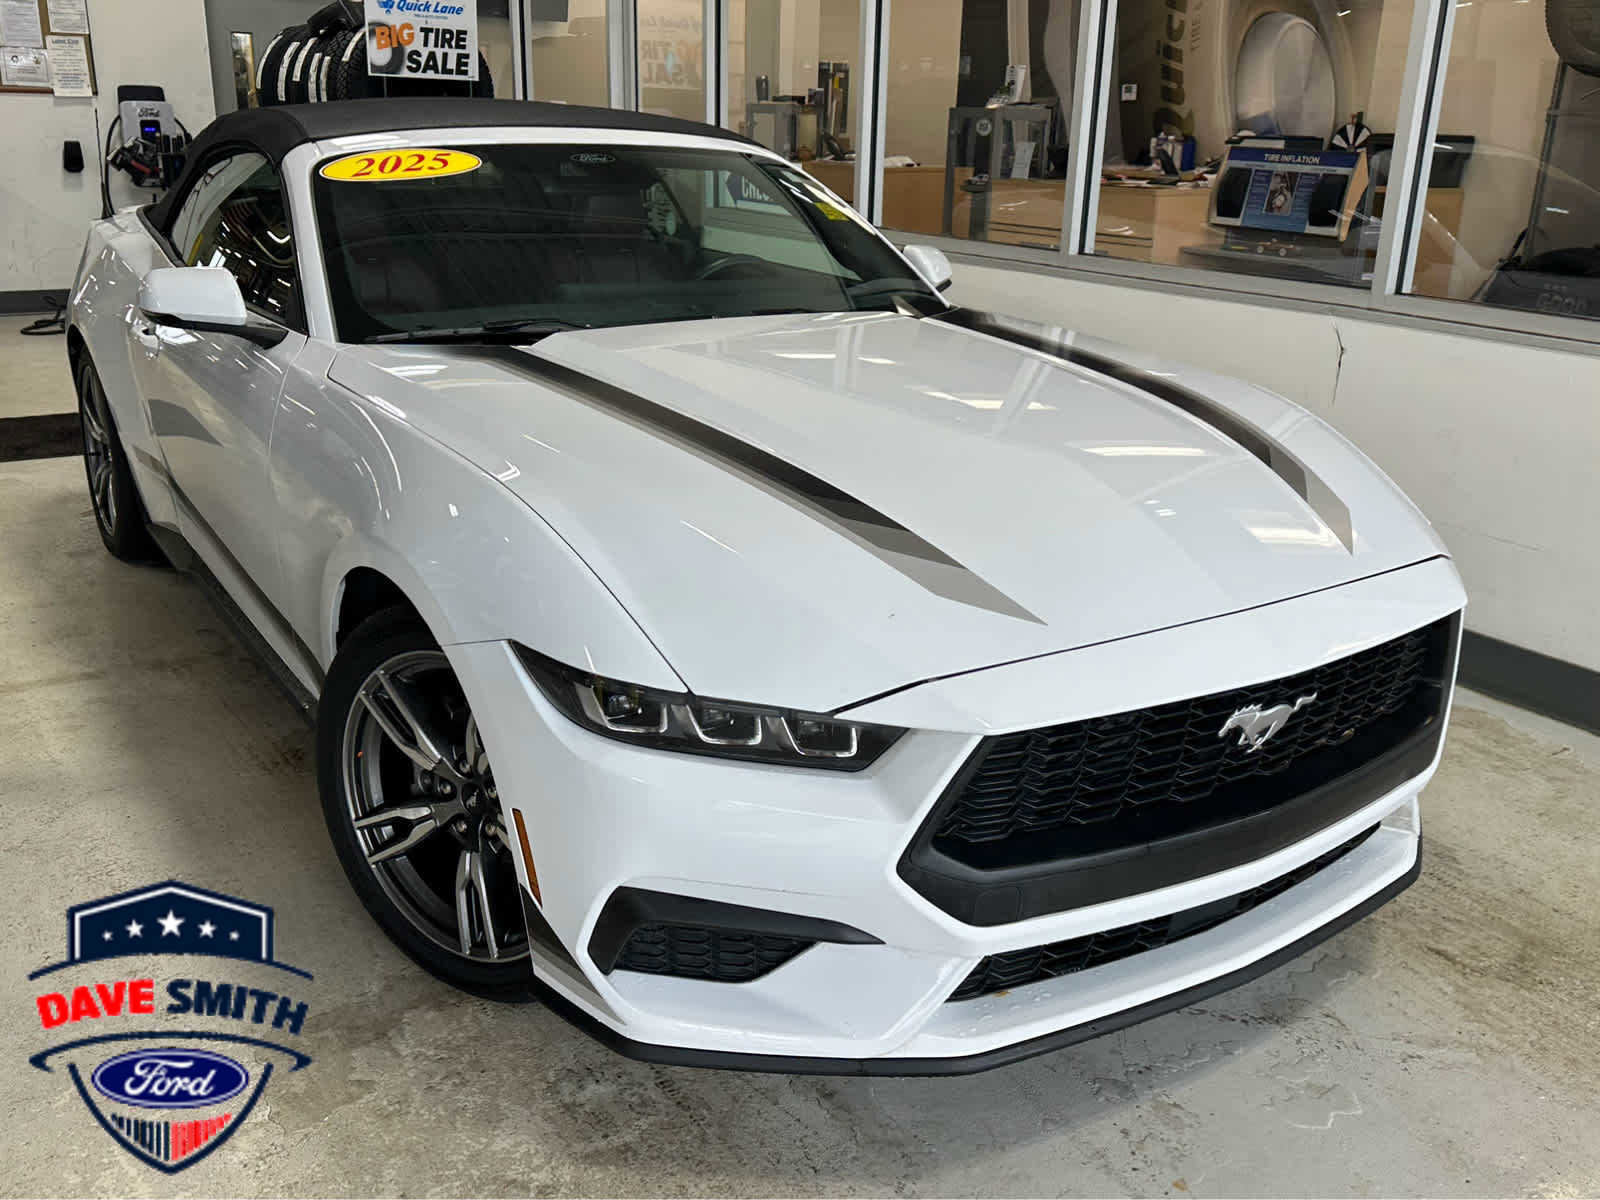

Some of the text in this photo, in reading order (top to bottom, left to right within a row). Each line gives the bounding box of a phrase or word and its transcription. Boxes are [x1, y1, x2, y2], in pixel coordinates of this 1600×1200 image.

[396, 0, 464, 15] Quick Lane
[375, 22, 468, 50] BIG TIRE
[406, 49, 470, 76] SALE
[351, 152, 451, 178] 2025
[1263, 153, 1321, 165] TIRE INFLATION
